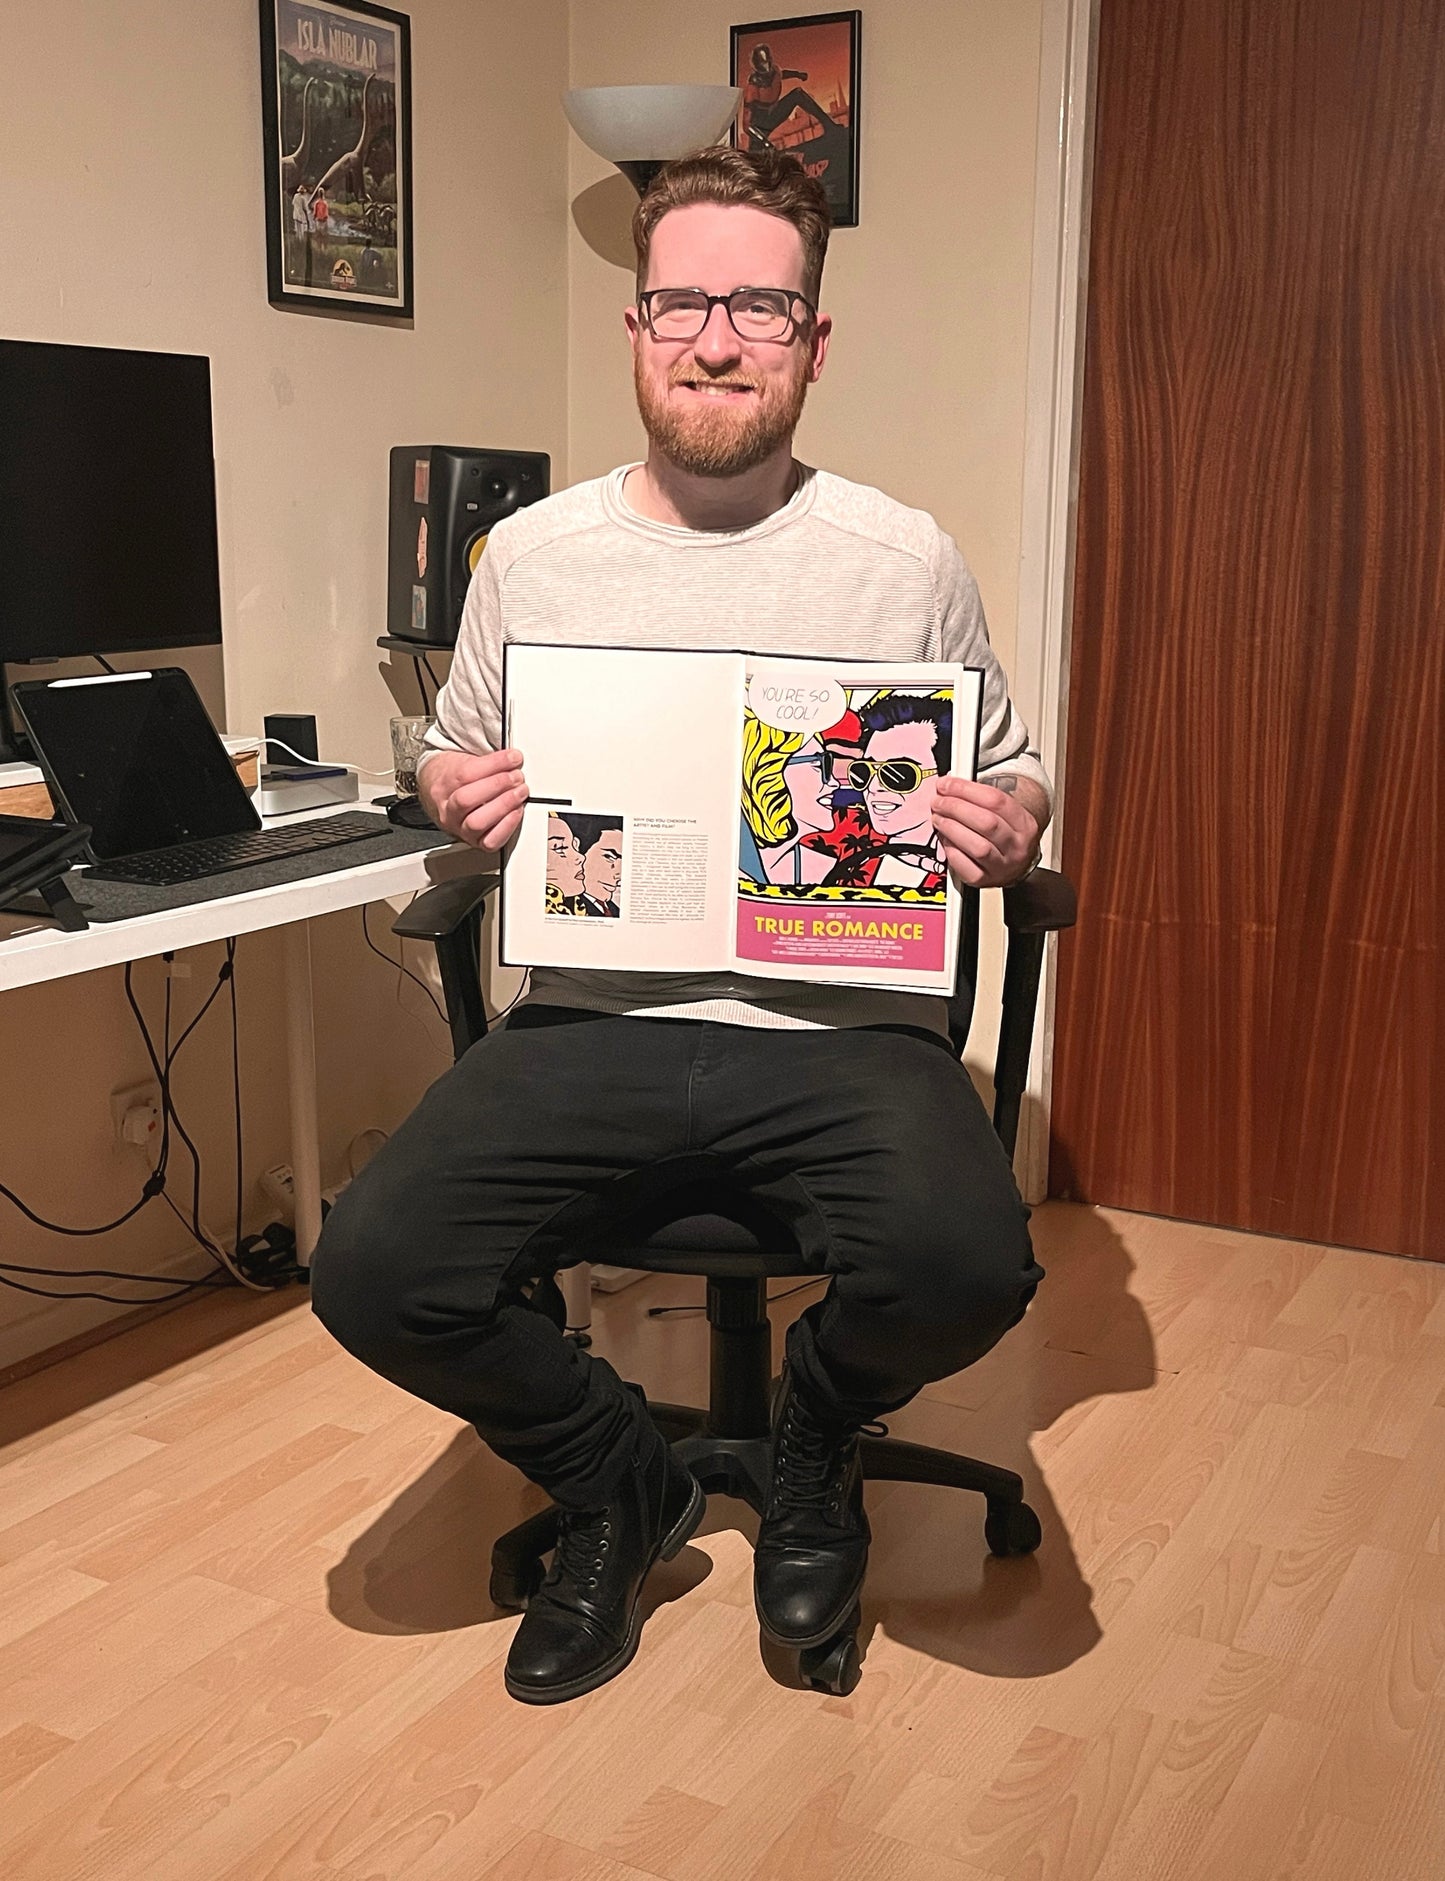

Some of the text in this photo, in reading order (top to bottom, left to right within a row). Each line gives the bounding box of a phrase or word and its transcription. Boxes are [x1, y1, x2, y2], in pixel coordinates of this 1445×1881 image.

[297, 18, 377, 70] ISLA NUBLAR
[809, 689, 830, 703] SO
[776, 705, 819, 720] COOL!
[754, 916, 923, 940] TRUE ROMANCE
